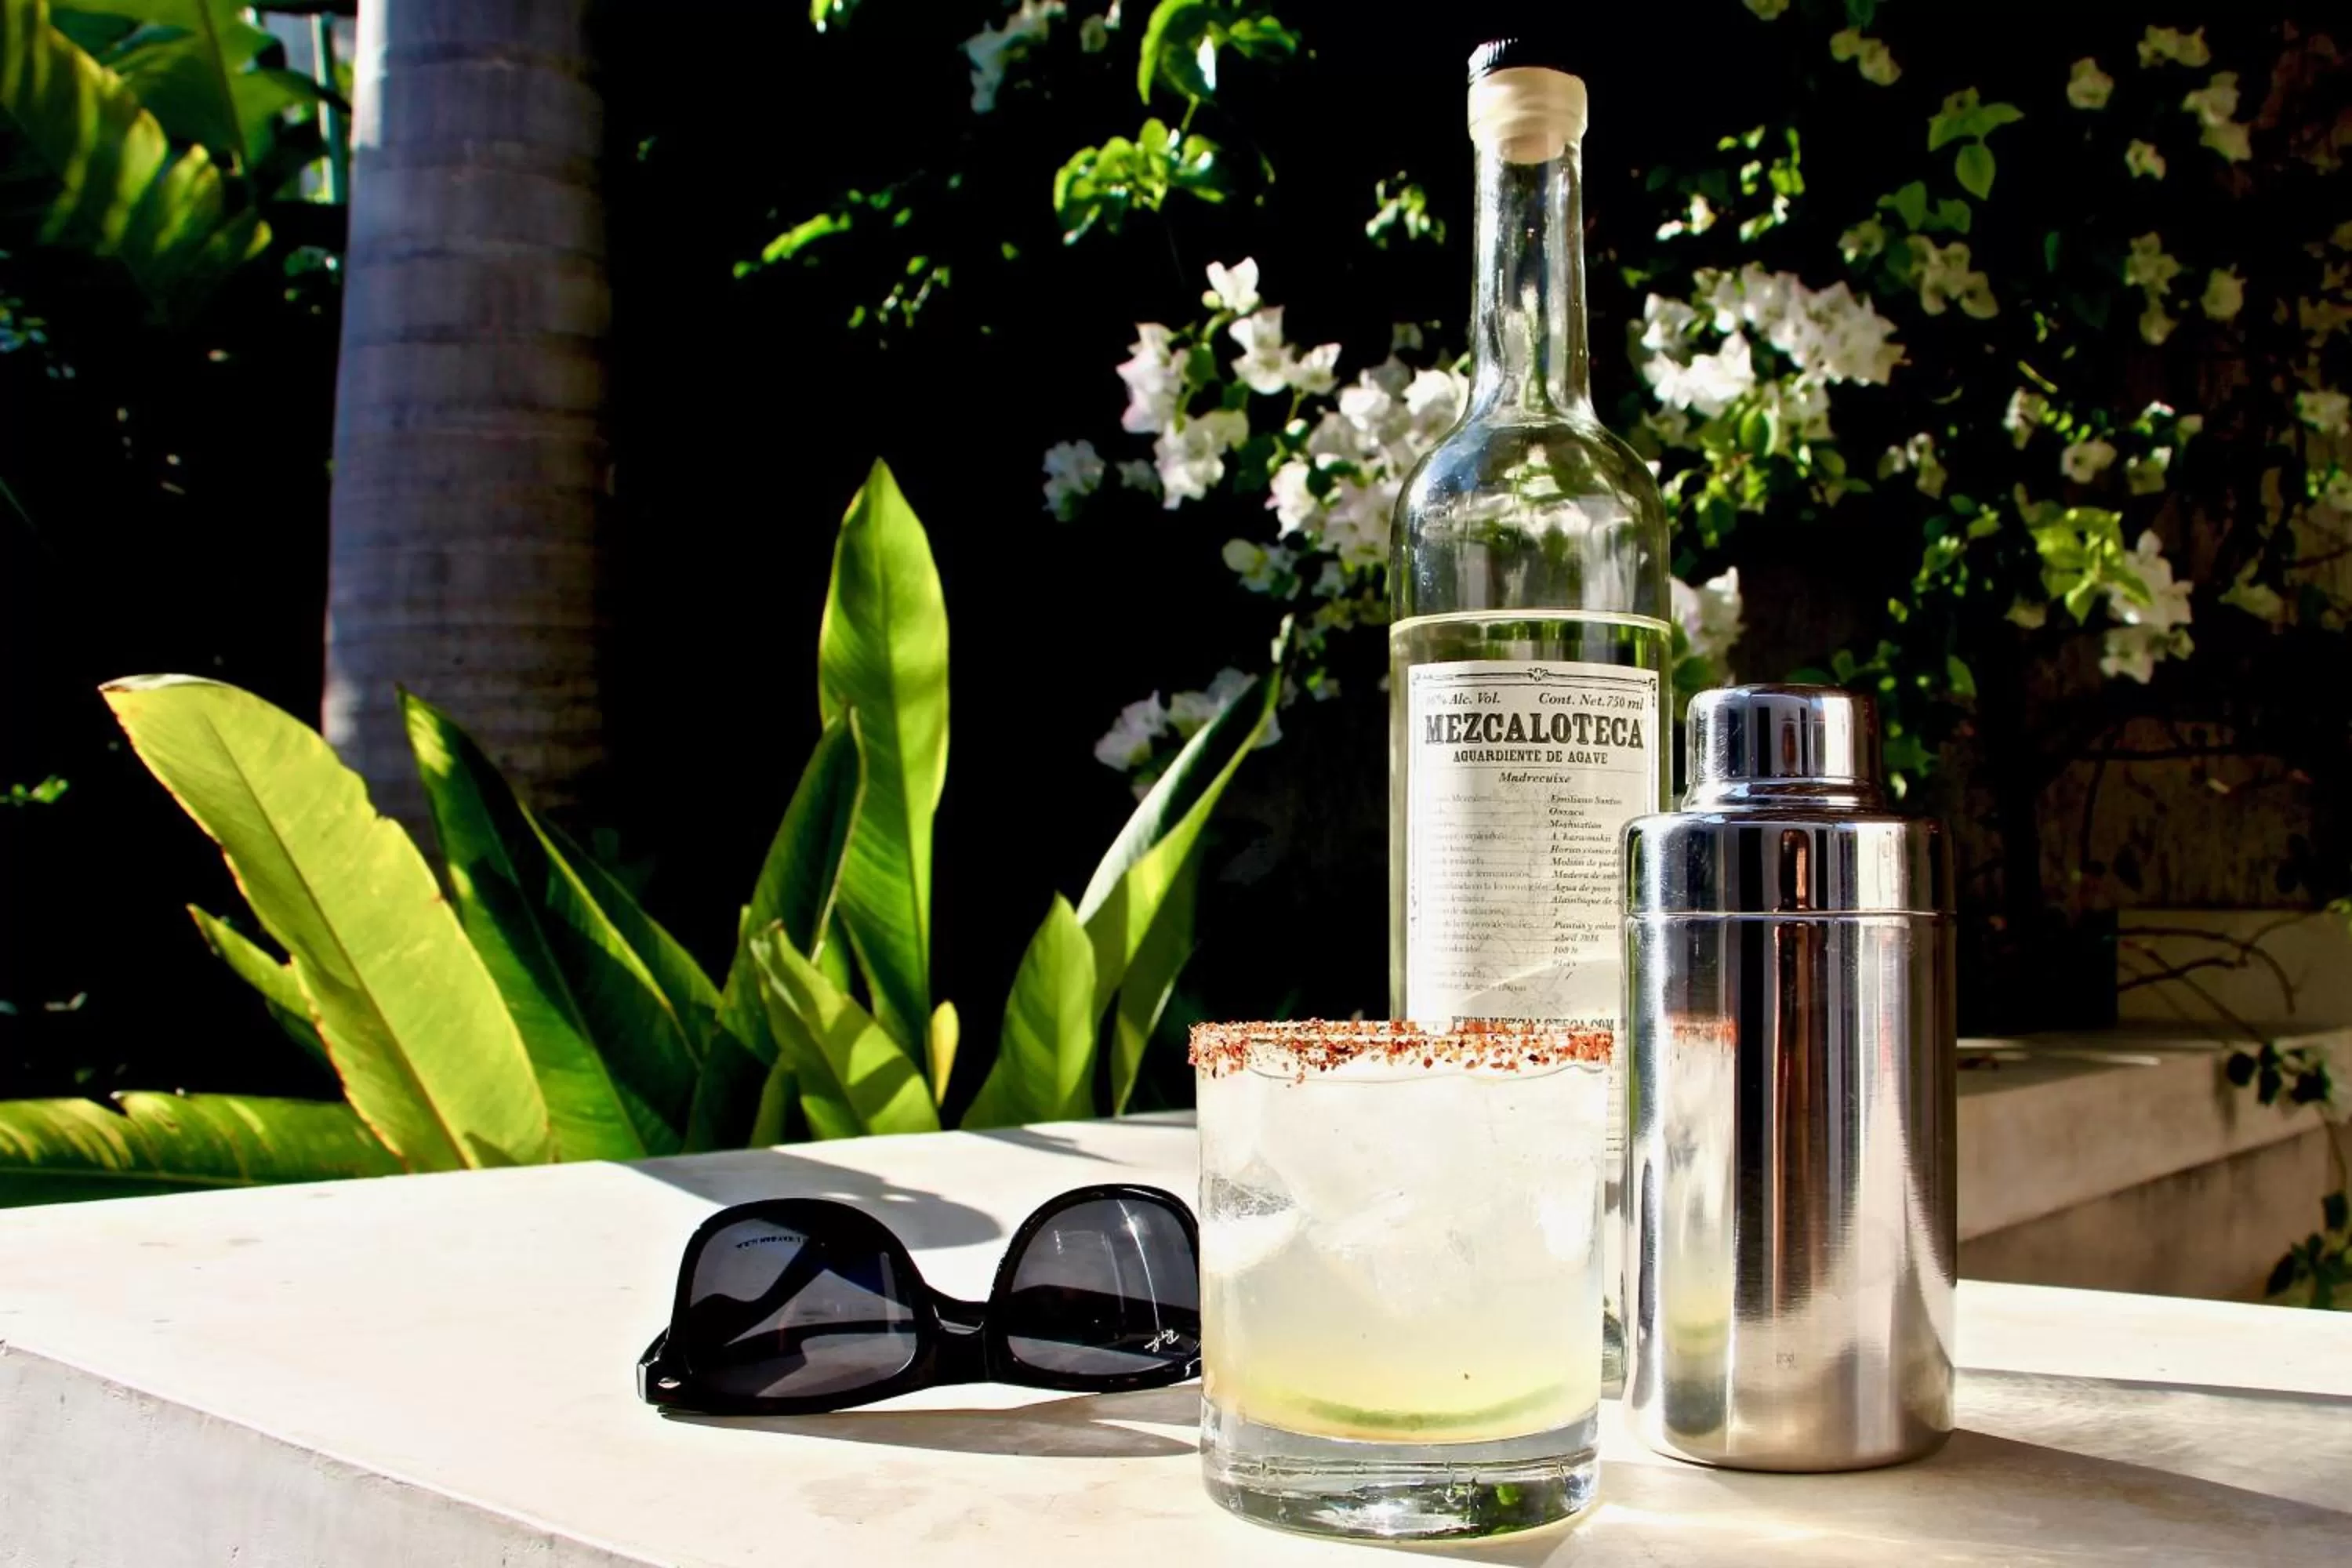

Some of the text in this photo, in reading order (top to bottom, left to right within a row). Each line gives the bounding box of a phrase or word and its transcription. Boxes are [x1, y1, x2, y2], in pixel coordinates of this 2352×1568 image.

[1478, 691, 1501, 704] Vol.
[1539, 692, 1575, 705] Cont.
[1425, 713, 1645, 749] MEZCALOTECA
[1454, 750, 1608, 764] AGUARDIENTE DE AGAVE
